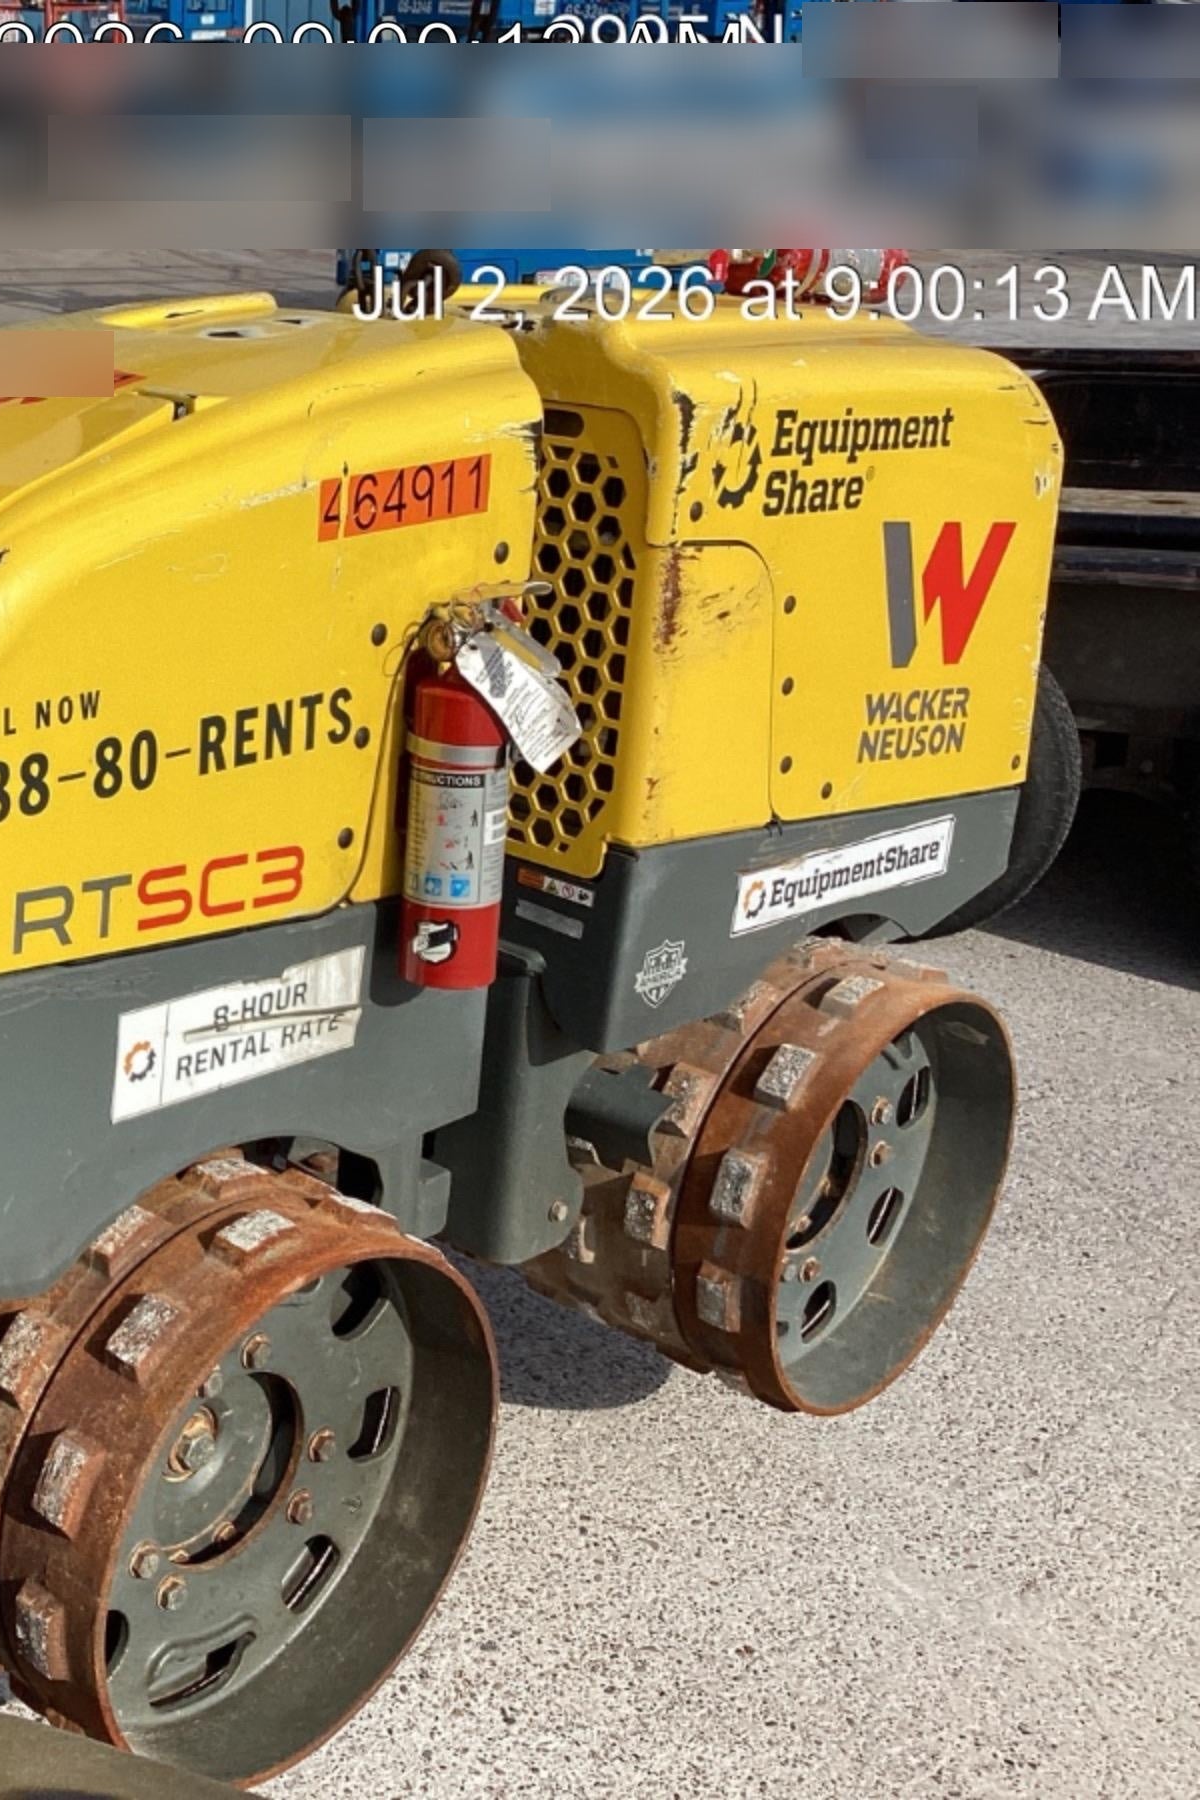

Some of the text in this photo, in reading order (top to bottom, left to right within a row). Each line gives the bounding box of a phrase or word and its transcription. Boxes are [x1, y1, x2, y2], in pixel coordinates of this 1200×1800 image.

[771, 408, 954, 466] Equipment
[323, 455, 482, 530] 464911
[35, 690, 100, 728] NOW
[866, 687, 970, 725] WACKER
[857, 722, 966, 763] NEUSON
[13, 845, 305, 954] RTSC3
[768, 839, 941, 909] EquipmentShare
[176, 1012, 344, 1081] RENTAL RATE
